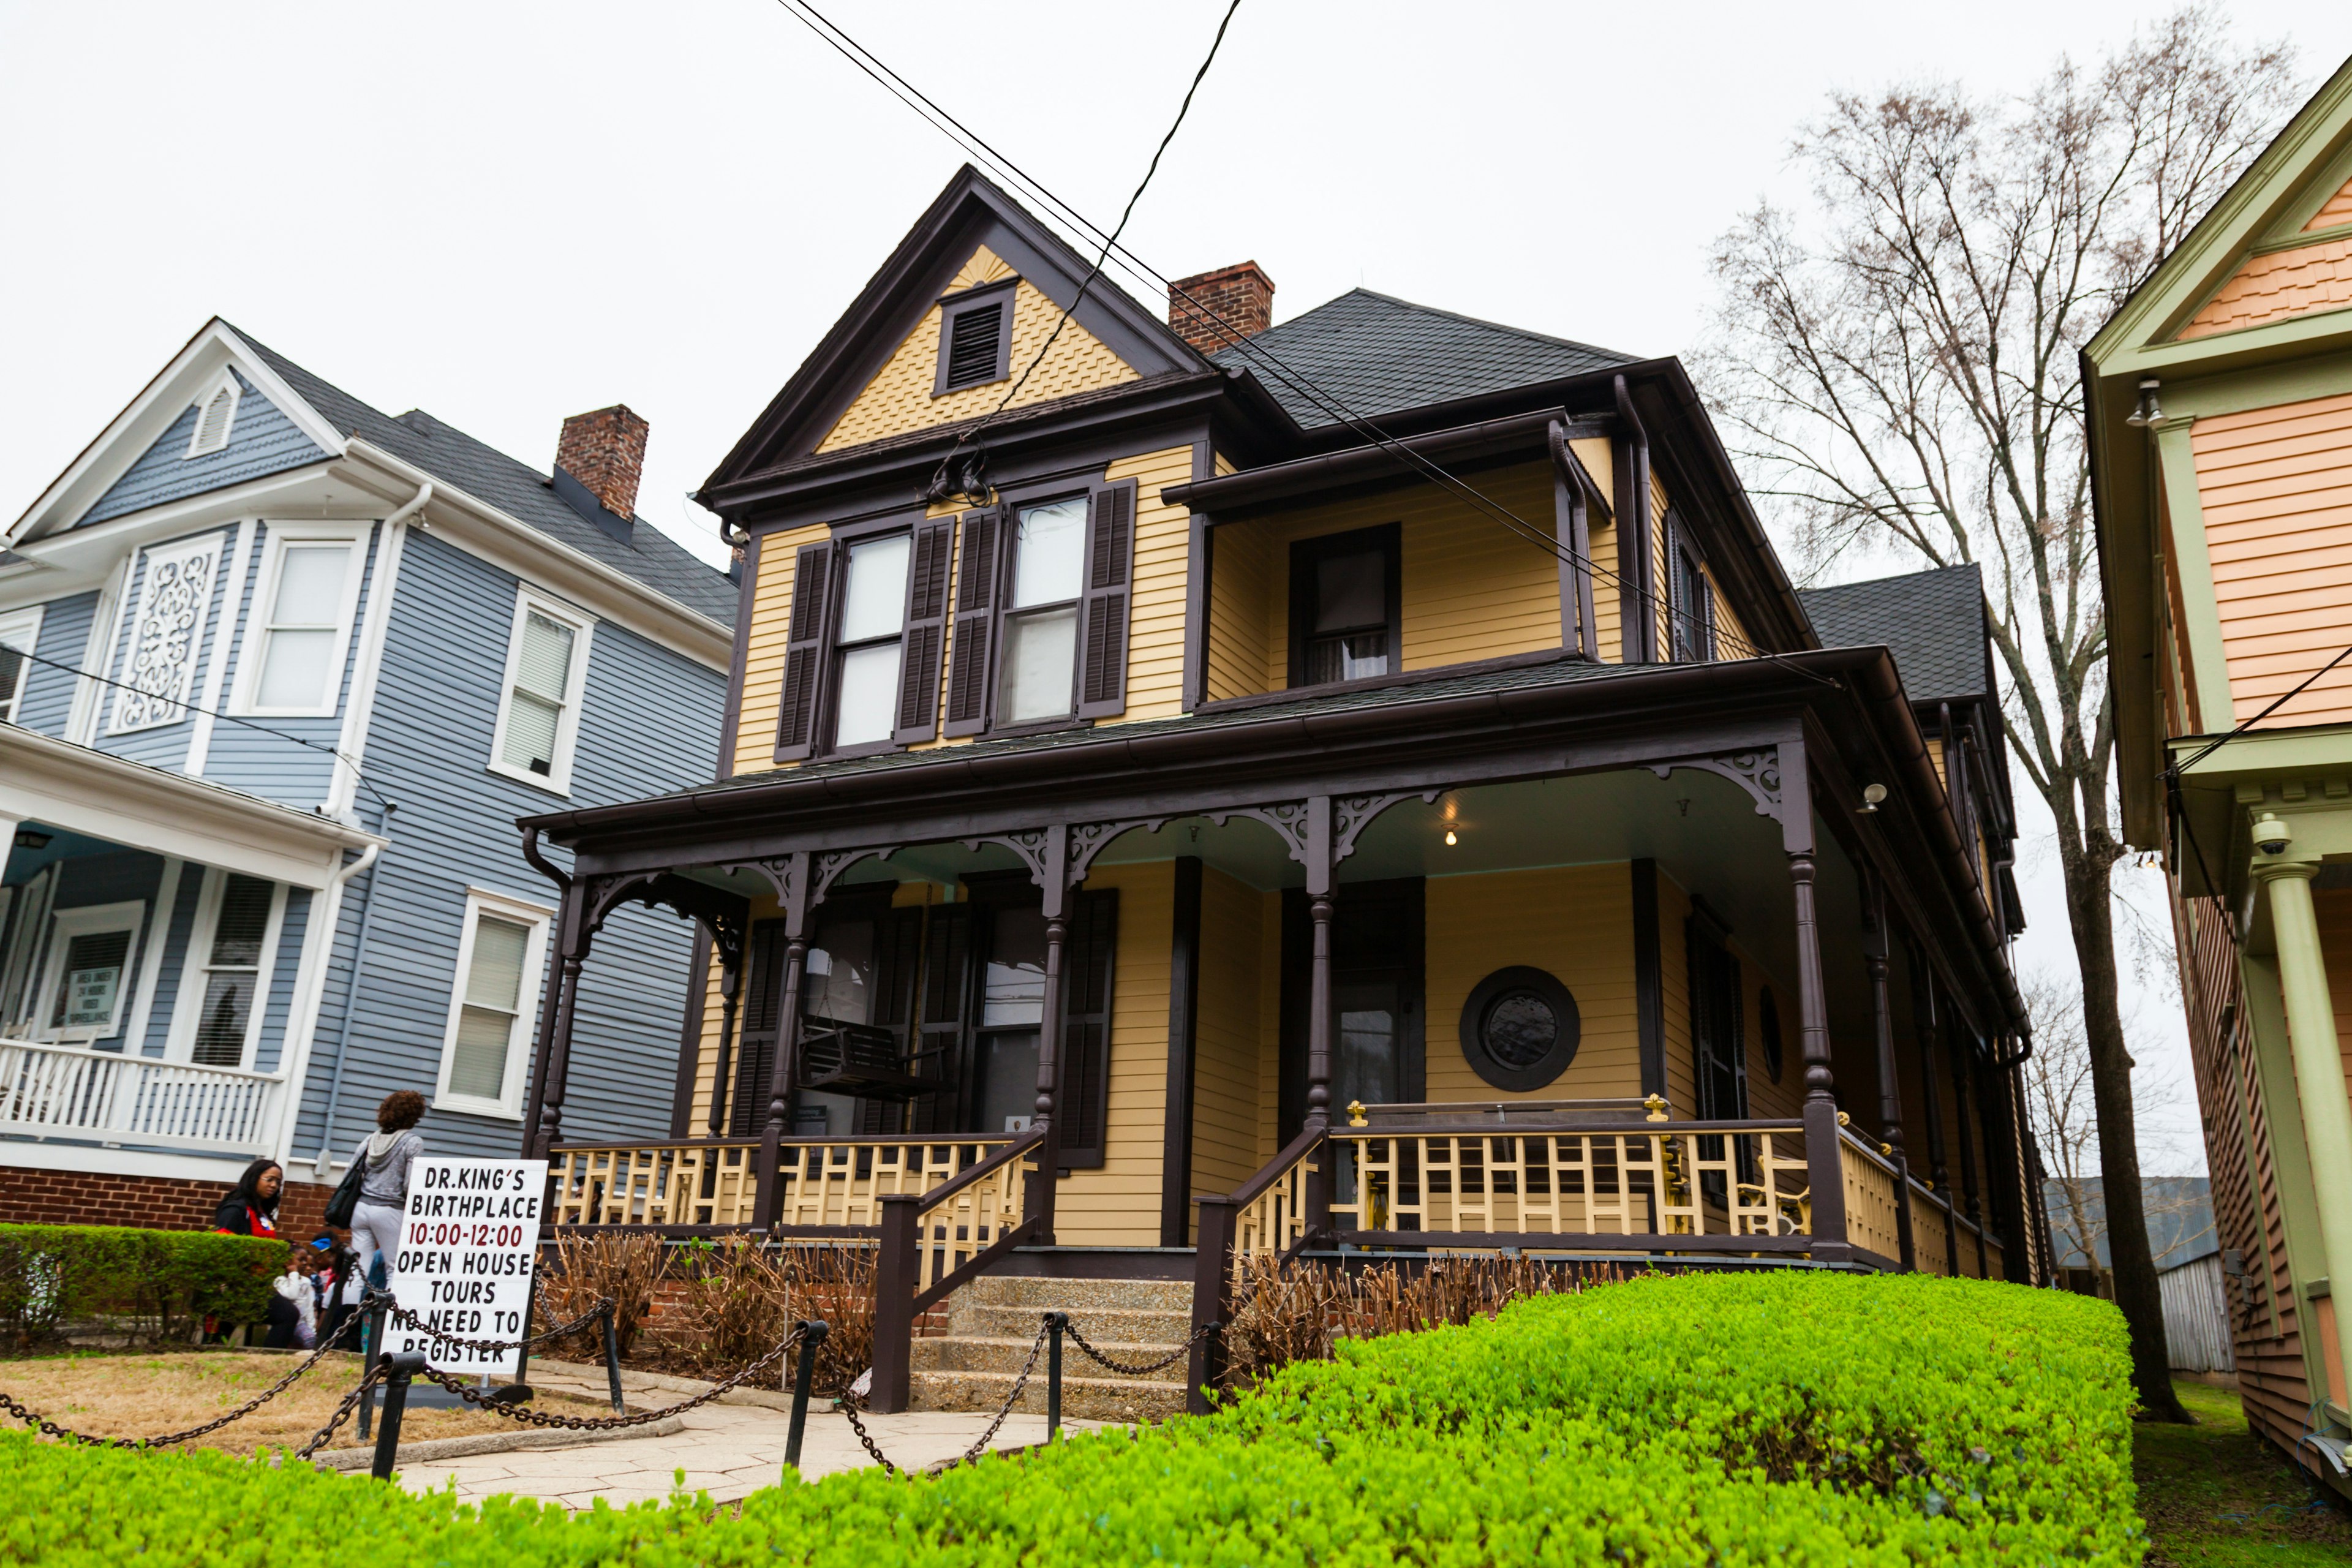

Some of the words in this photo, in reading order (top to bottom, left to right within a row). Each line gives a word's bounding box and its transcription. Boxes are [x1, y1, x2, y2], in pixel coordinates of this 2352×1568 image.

[424, 1167, 524, 1191] DR.KING'S
[411, 1194, 538, 1219] BIRTHPLACE
[409, 1223, 522, 1247] 10:00-12:00
[398, 1251, 452, 1274] OPEN
[462, 1252, 530, 1275] HOUSE
[431, 1281, 496, 1304] TOURS
[391, 1309, 418, 1332] NO
[429, 1310, 481, 1333] NEED
[494, 1311, 519, 1334] TO
